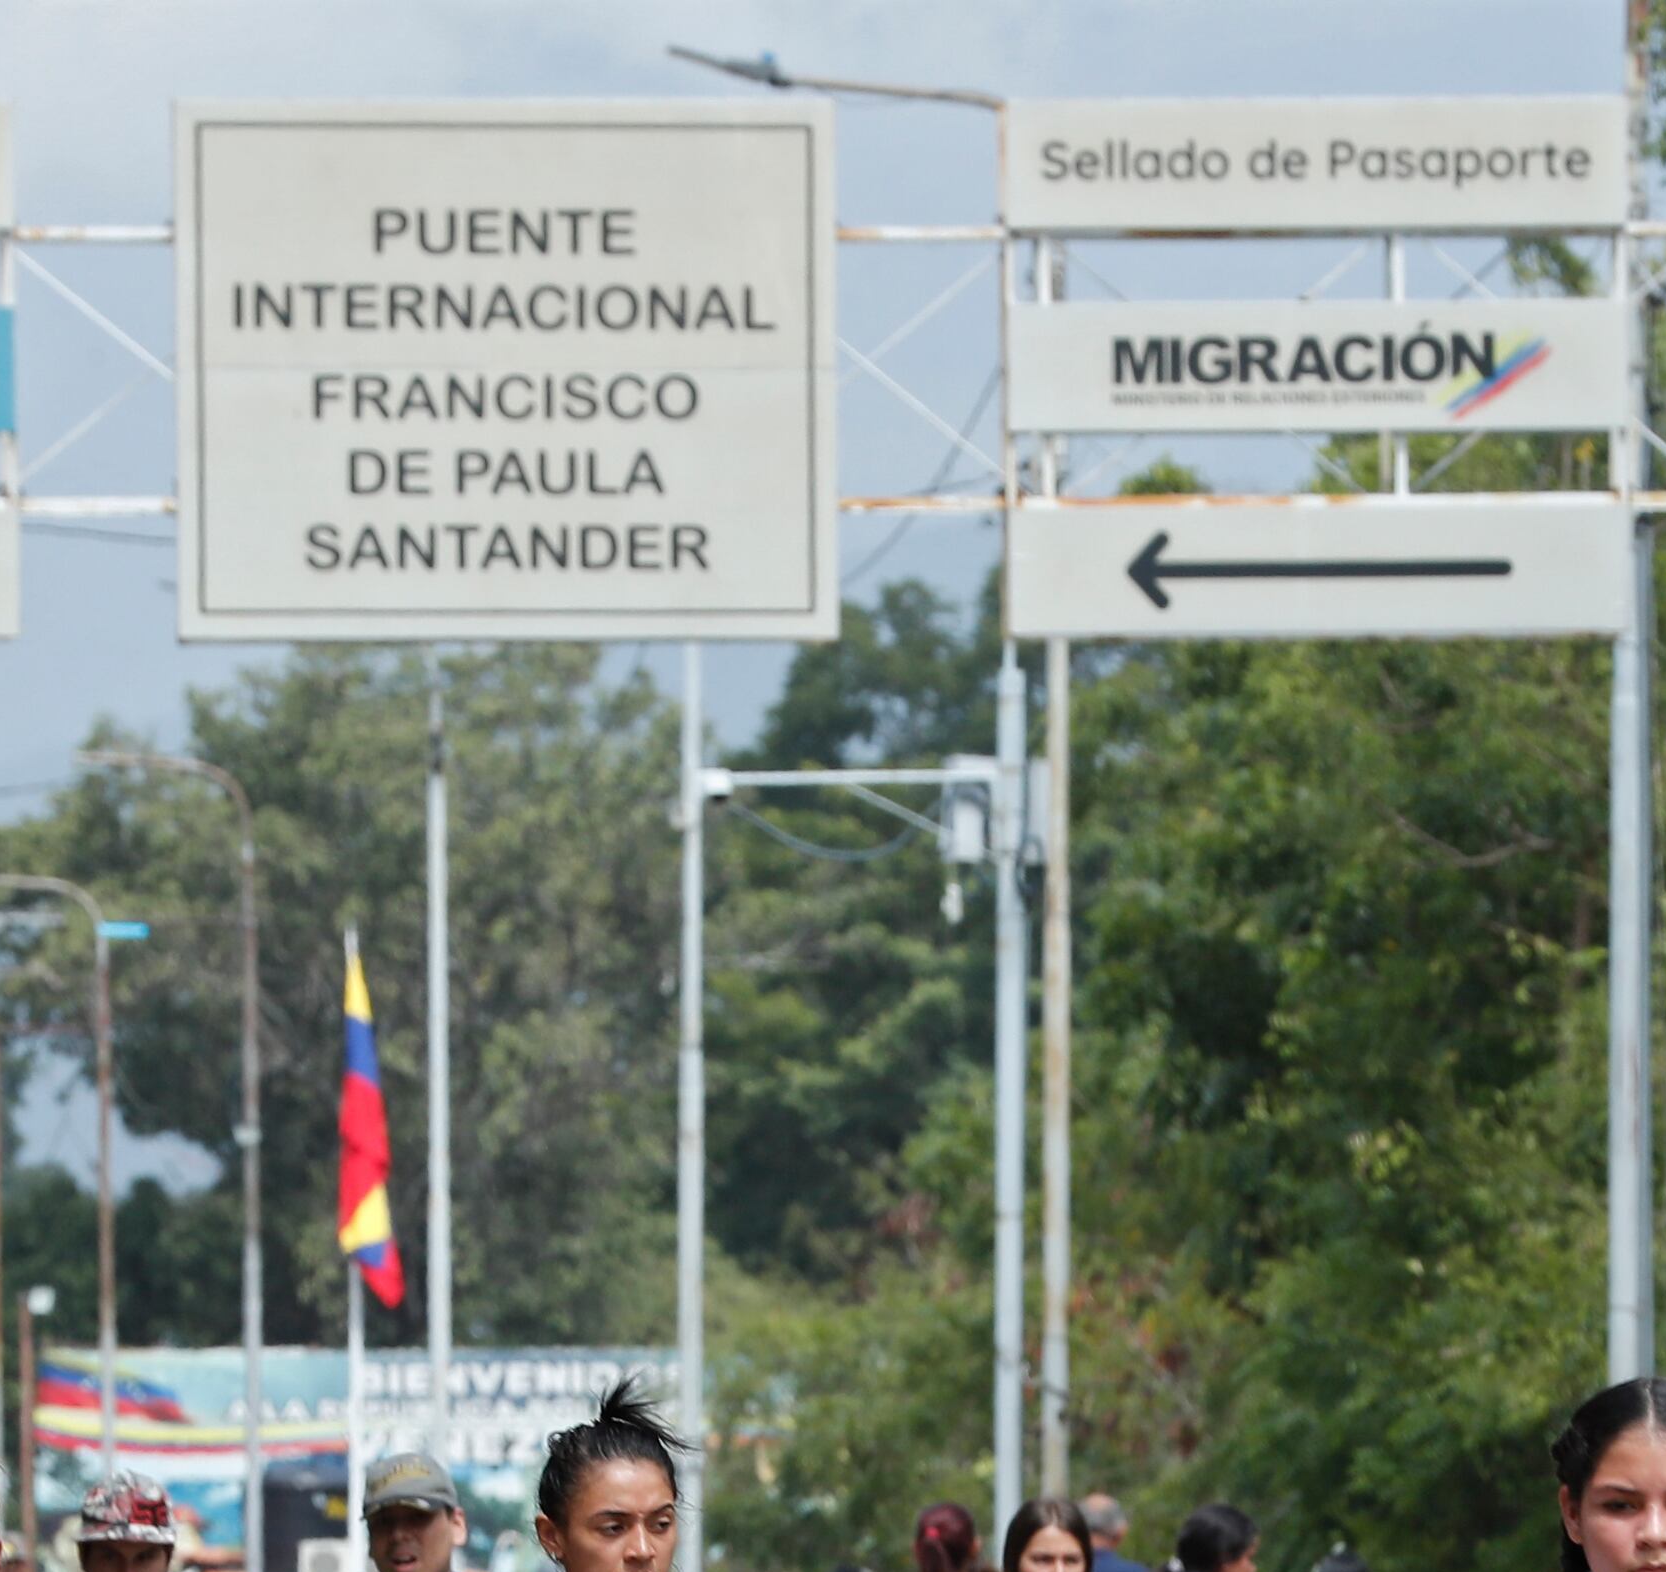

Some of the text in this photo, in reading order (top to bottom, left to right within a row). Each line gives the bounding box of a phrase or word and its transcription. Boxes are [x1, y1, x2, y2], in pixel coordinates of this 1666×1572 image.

[1040, 138, 1593, 190] Sellado de Pasaporte
[371, 207, 636, 257] PUENTE
[231, 282, 776, 332] INTERNACIONAL
[1111, 322, 1495, 385] MIGRACIÓN
[310, 372, 701, 422] FRANCISCO
[346, 448, 666, 497] DE PAULA
[304, 523, 710, 572] SANTANDER
